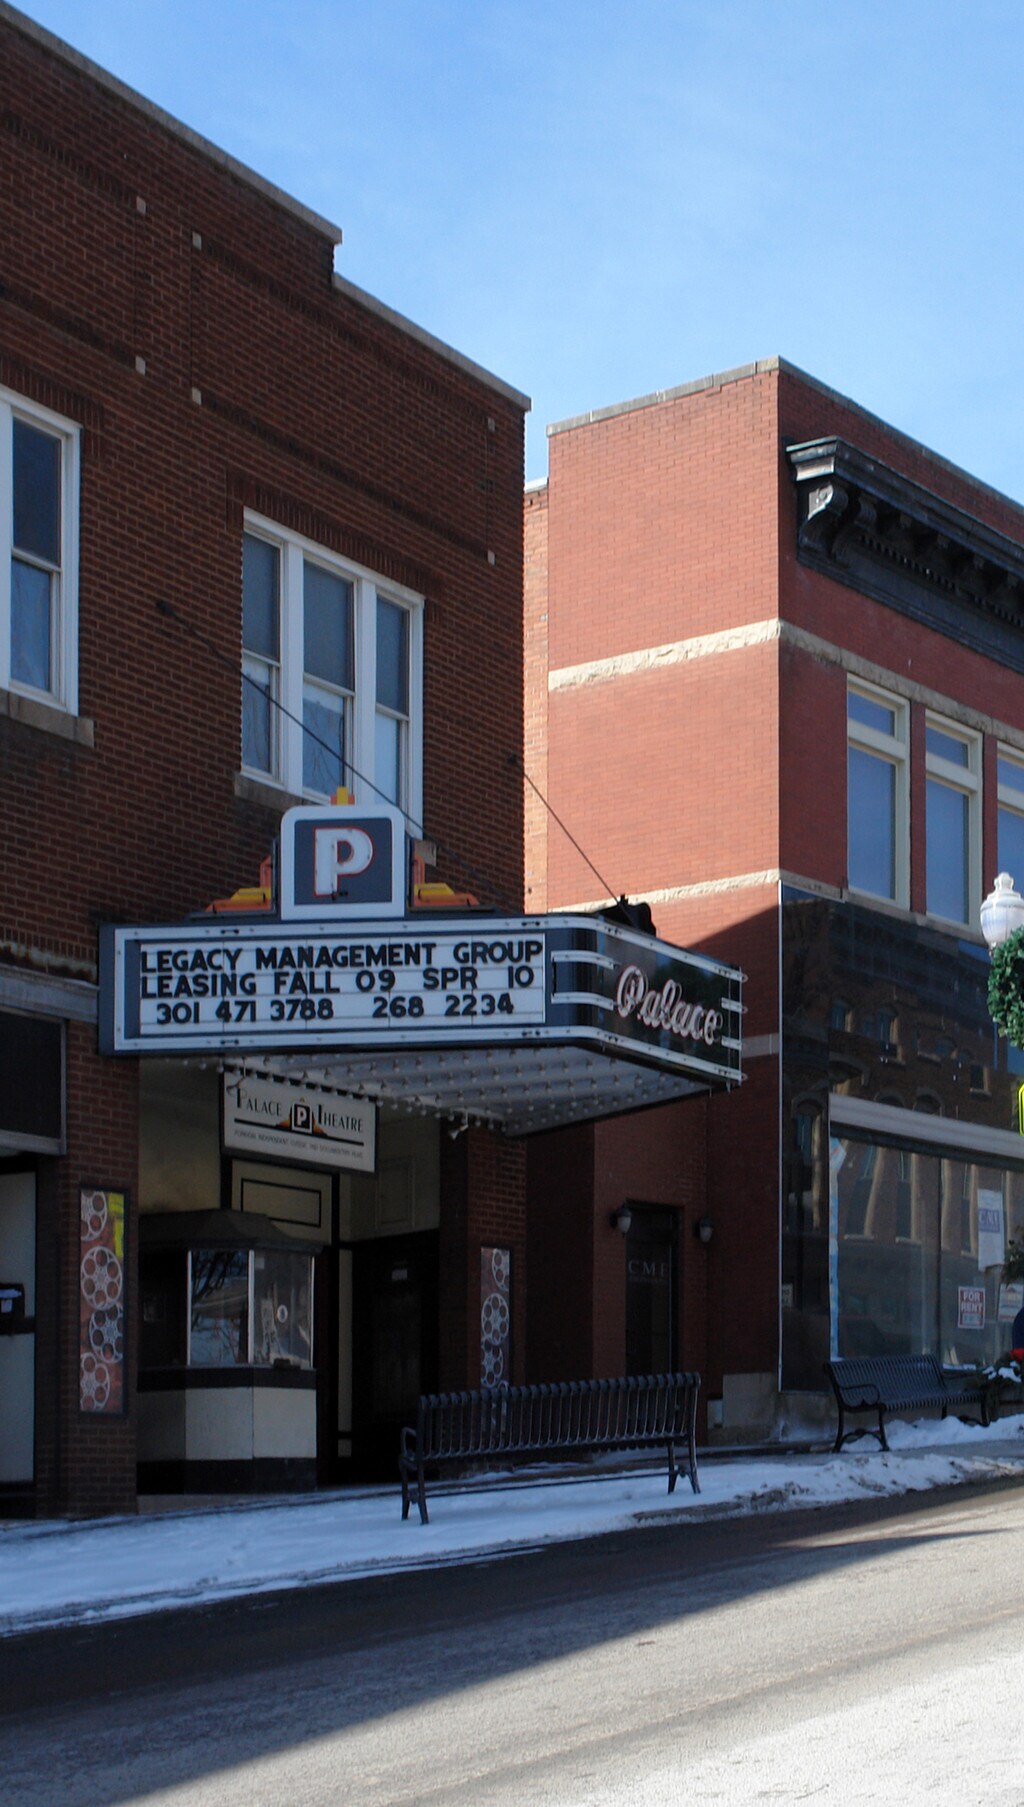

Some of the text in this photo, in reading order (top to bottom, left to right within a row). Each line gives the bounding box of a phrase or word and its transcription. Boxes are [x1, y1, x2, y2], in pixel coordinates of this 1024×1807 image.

[313, 826, 374, 897] P
[141, 940, 544, 973] LEGACY MANAGEMENT GROUP
[141, 965, 535, 998] LEASING FALL 09 SPR 10
[157, 992, 515, 1025] 301 471 3788 268 2234
[617, 965, 719, 1046] Palace
[236, 1087, 282, 1118] PALACE
[317, 1104, 363, 1133] THEATRE
[961, 1301, 983, 1313] RENT
[963, 1290, 981, 1301] FOR
